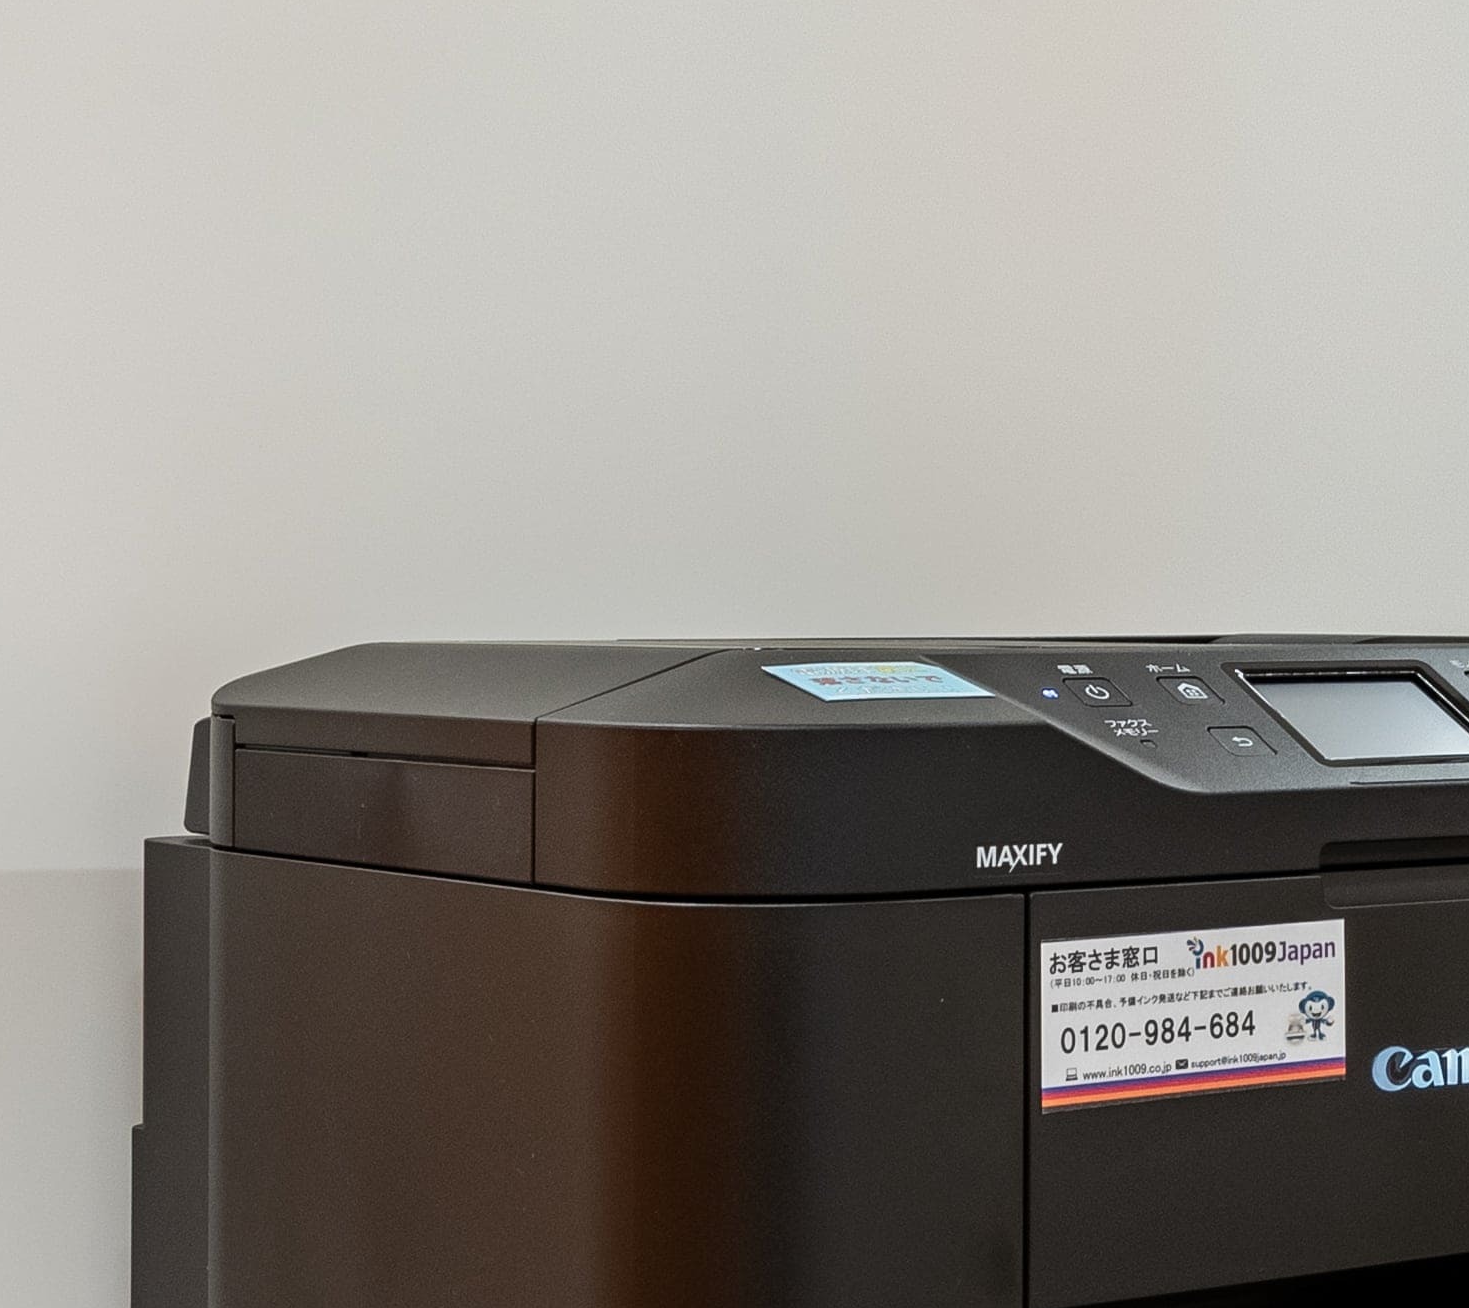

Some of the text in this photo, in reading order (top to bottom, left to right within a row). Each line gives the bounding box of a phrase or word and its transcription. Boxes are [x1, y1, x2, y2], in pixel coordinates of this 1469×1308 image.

[976, 842, 1063, 873] MAXIFY
[1049, 945, 1159, 975] お客さま窓口
[1190, 938, 1336, 969] ink1009Japan
[1060, 1009, 1256, 1054] 0120-984-684
[1082, 1063, 1172, 1081] www.ink1009.co.jp
